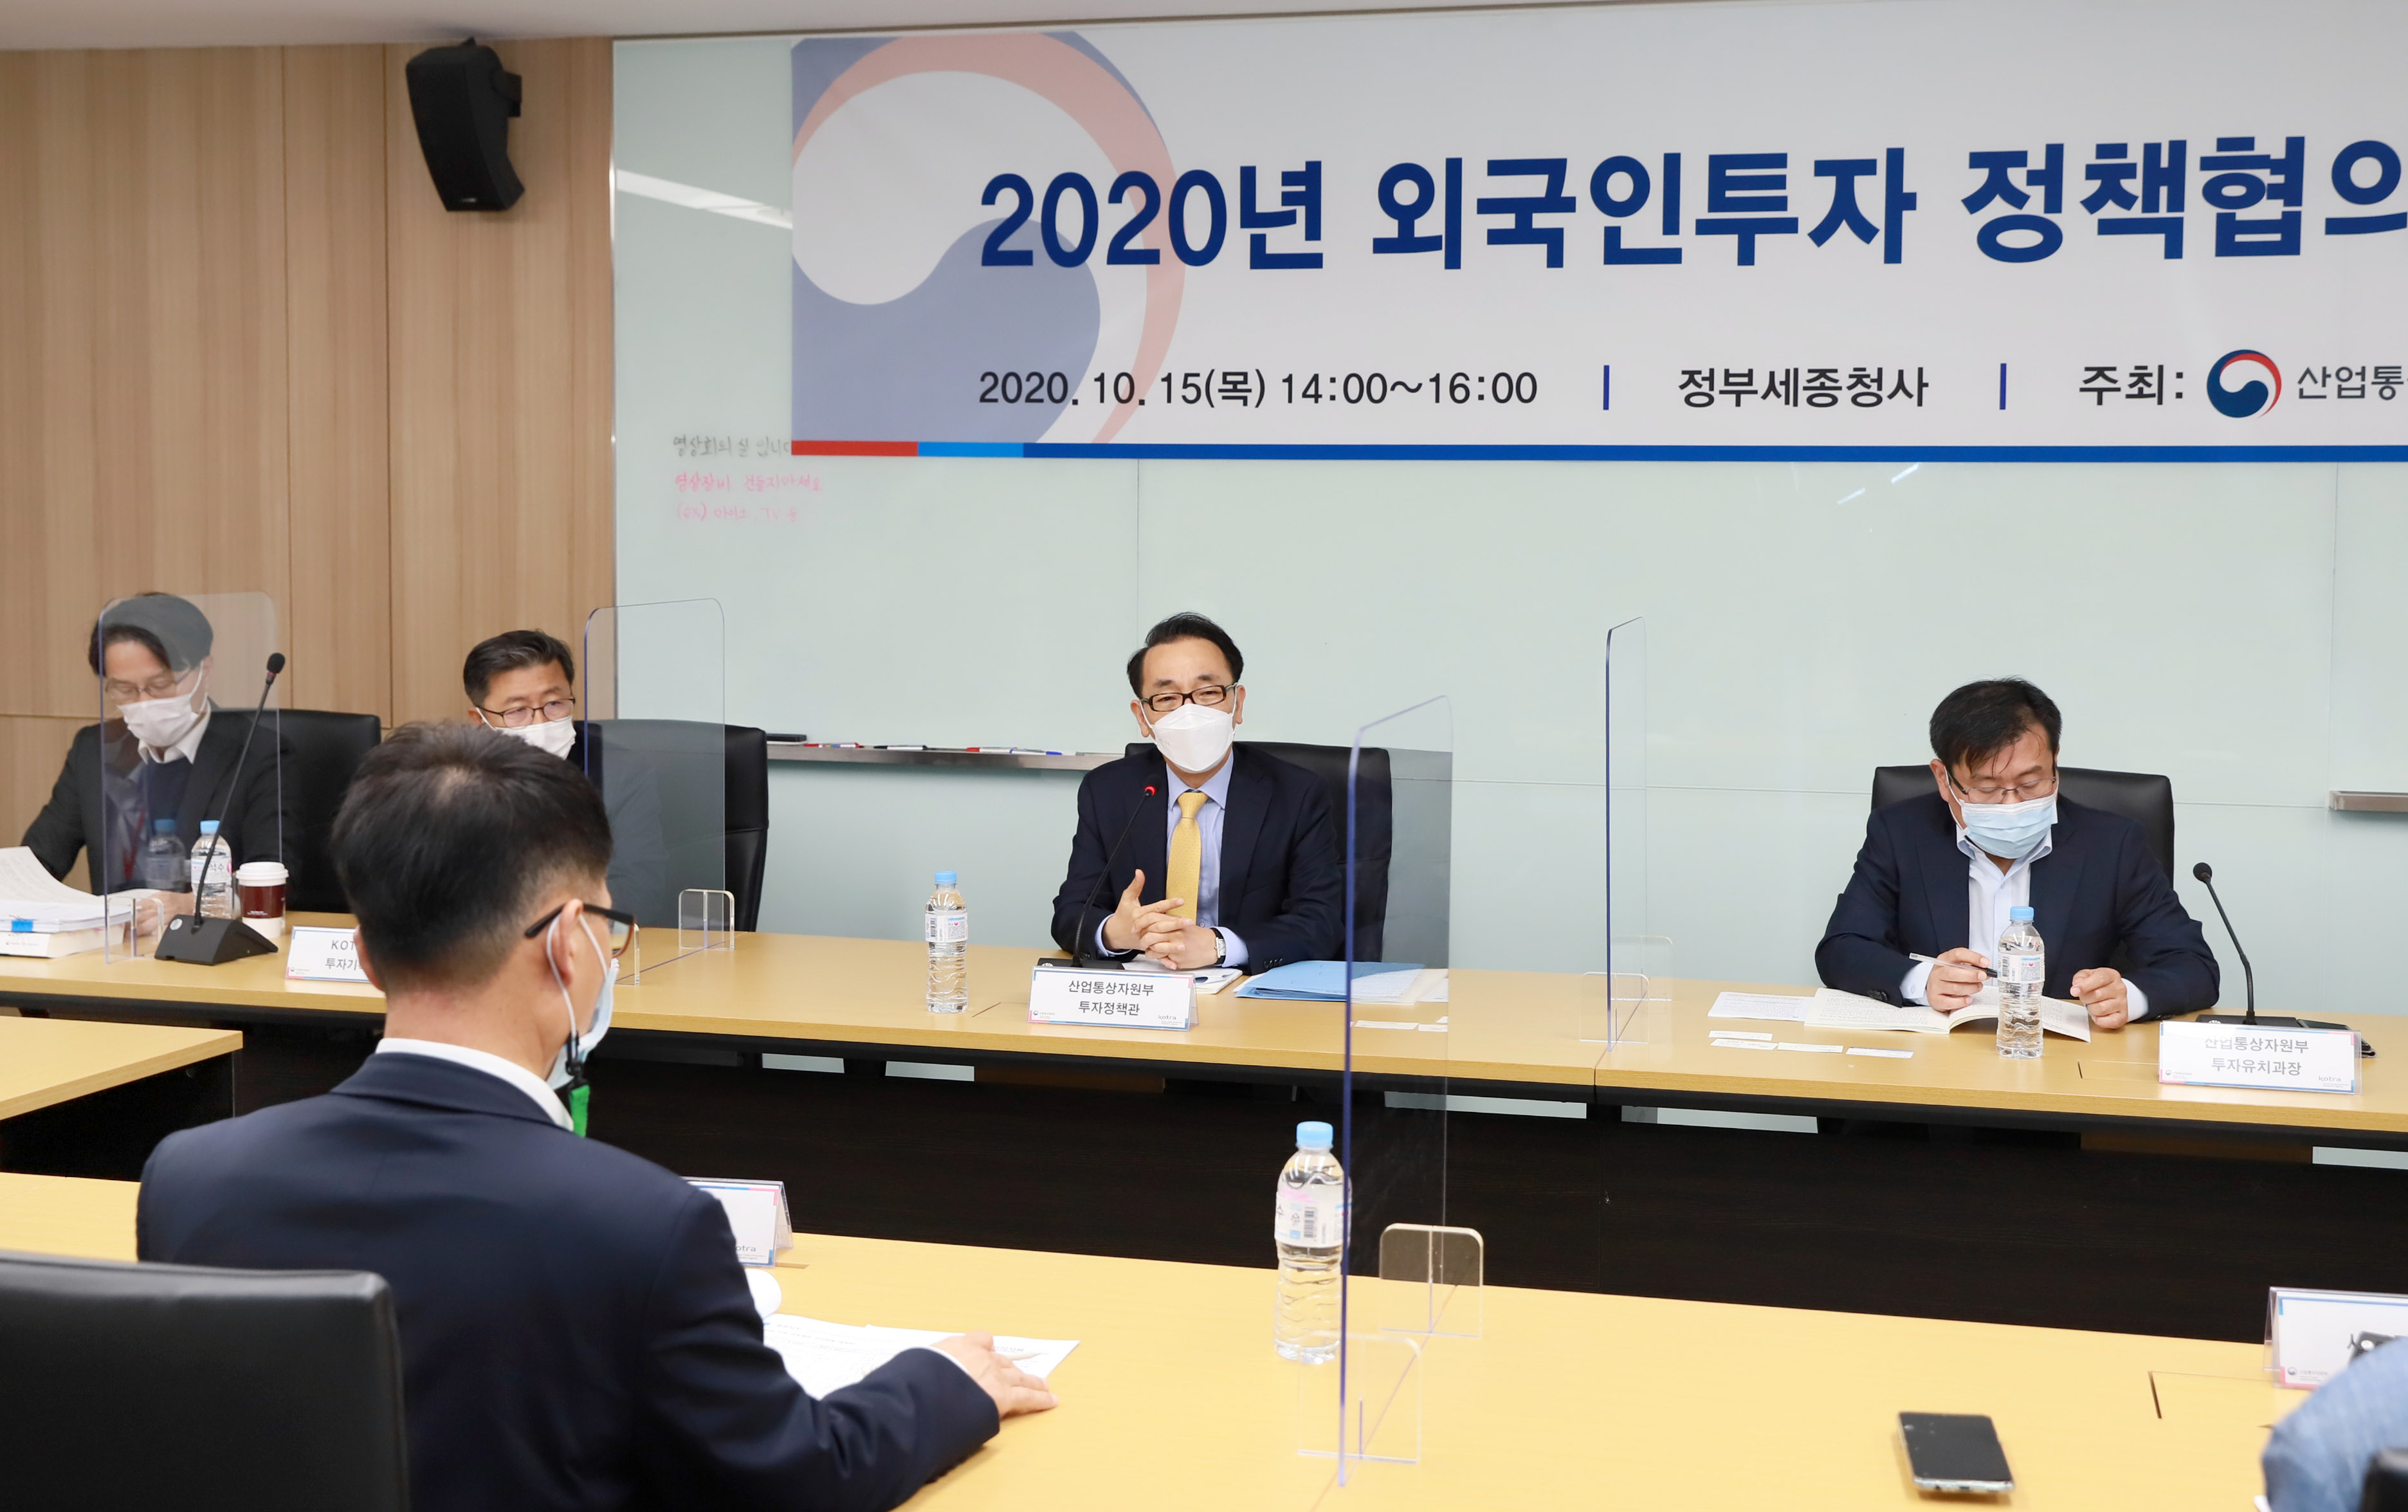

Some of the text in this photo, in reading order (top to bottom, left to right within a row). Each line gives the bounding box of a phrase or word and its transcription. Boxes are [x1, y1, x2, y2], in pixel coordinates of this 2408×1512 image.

[981, 160, 1324, 269] 2020년
[1373, 147, 1917, 269] 외국인투자
[979, 371, 1079, 406] 2020.
[1093, 371, 1146, 406] 10.
[1161, 369, 1266, 408] 15(목)
[1678, 366, 1929, 408] 정부세종청사
[2079, 364, 2184, 406] 주최:
[2297, 365, 2408, 401] 산업통
[675, 470, 731, 493] 영상장비
[331, 939, 356, 951] KOT
[1068, 979, 1154, 997] 산업통상자원부
[1078, 1000, 1140, 1016] 투자정책관
[2203, 1035, 2309, 1054] 산업통상자원부
[2211, 1057, 2302, 1076] 투자유치과장
